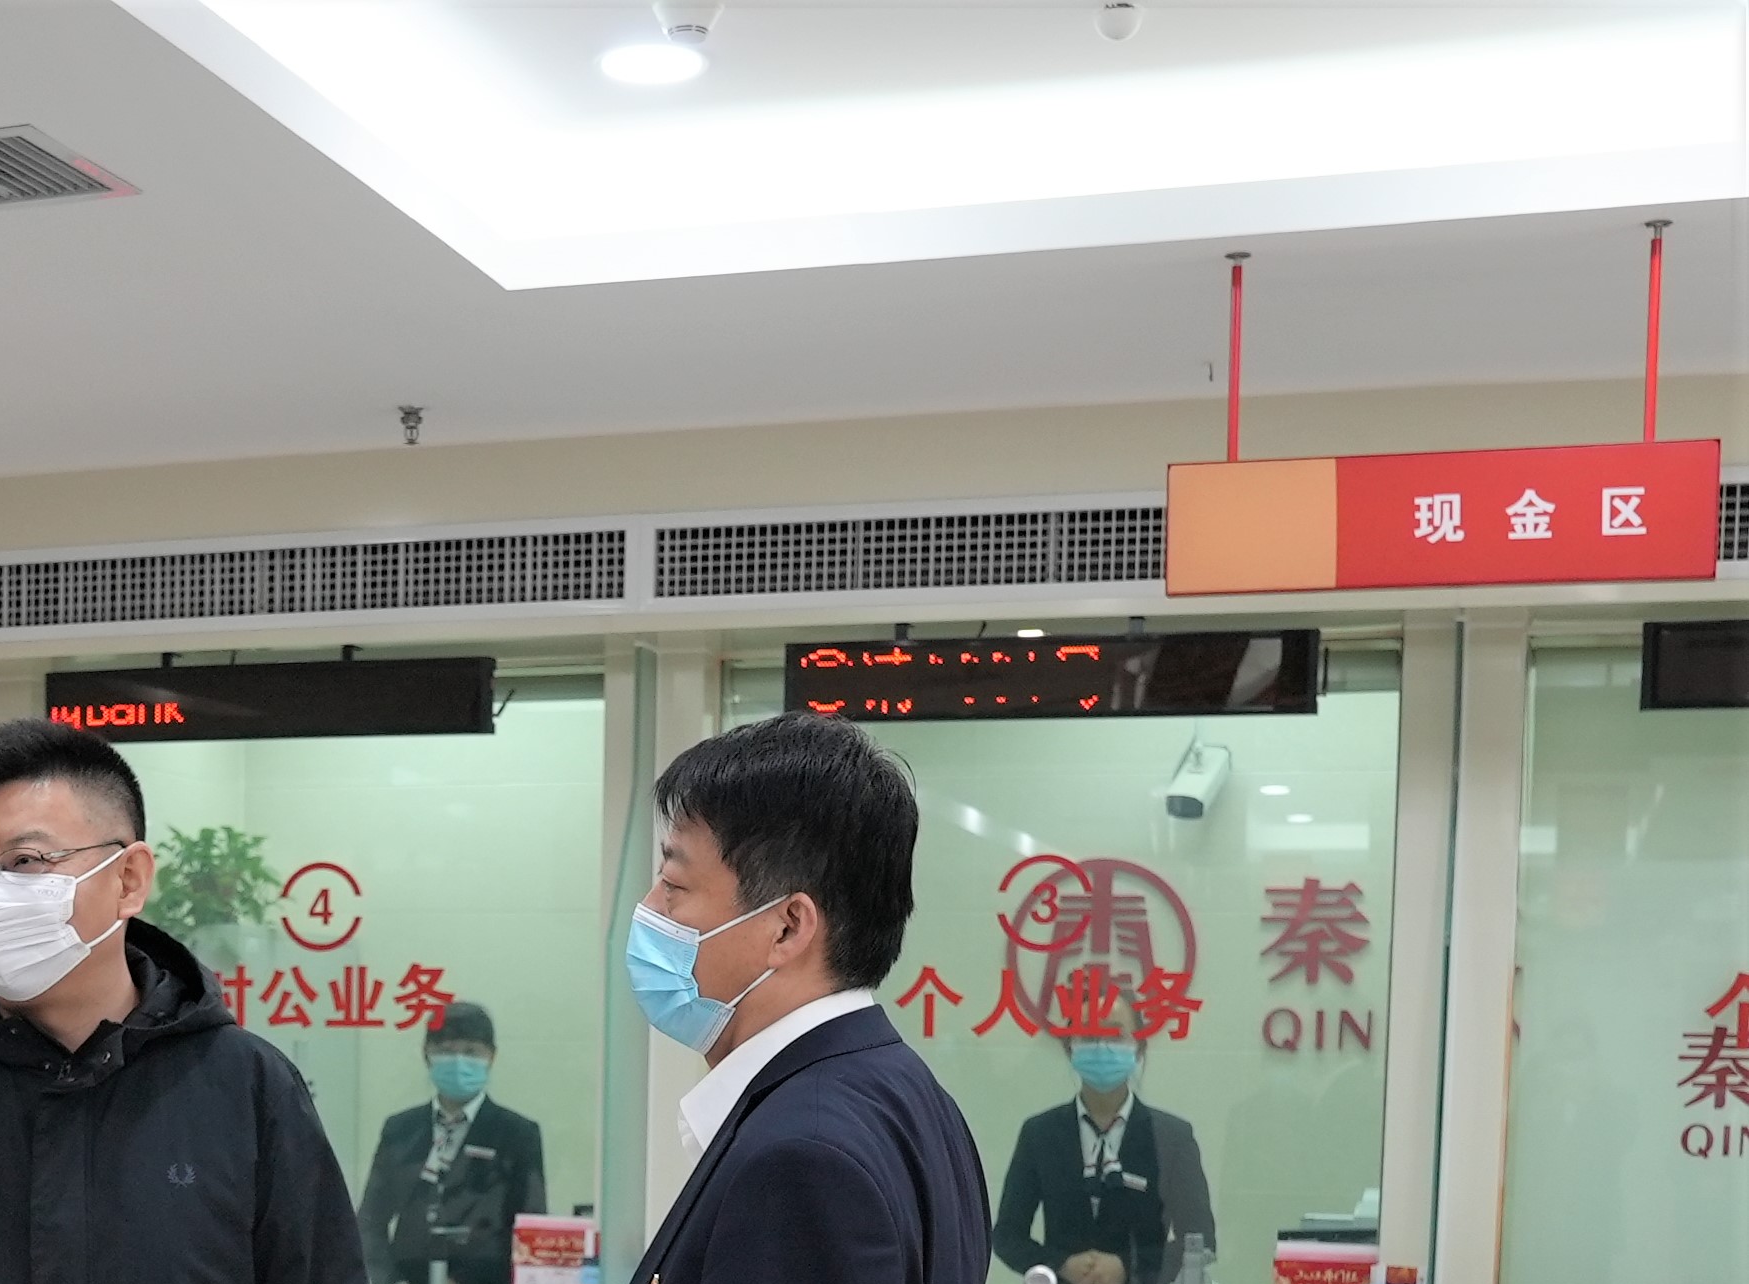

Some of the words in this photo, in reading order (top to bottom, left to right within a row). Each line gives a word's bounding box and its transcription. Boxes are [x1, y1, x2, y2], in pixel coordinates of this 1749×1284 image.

[1413, 486, 1648, 544] 现金区
[308, 888, 334, 926] 4
[1030, 882, 1060, 924] 3
[1260, 876, 1371, 986] 秦
[897, 964, 1204, 1041] 个人业务
[1262, 1008, 1373, 1052] QIN
